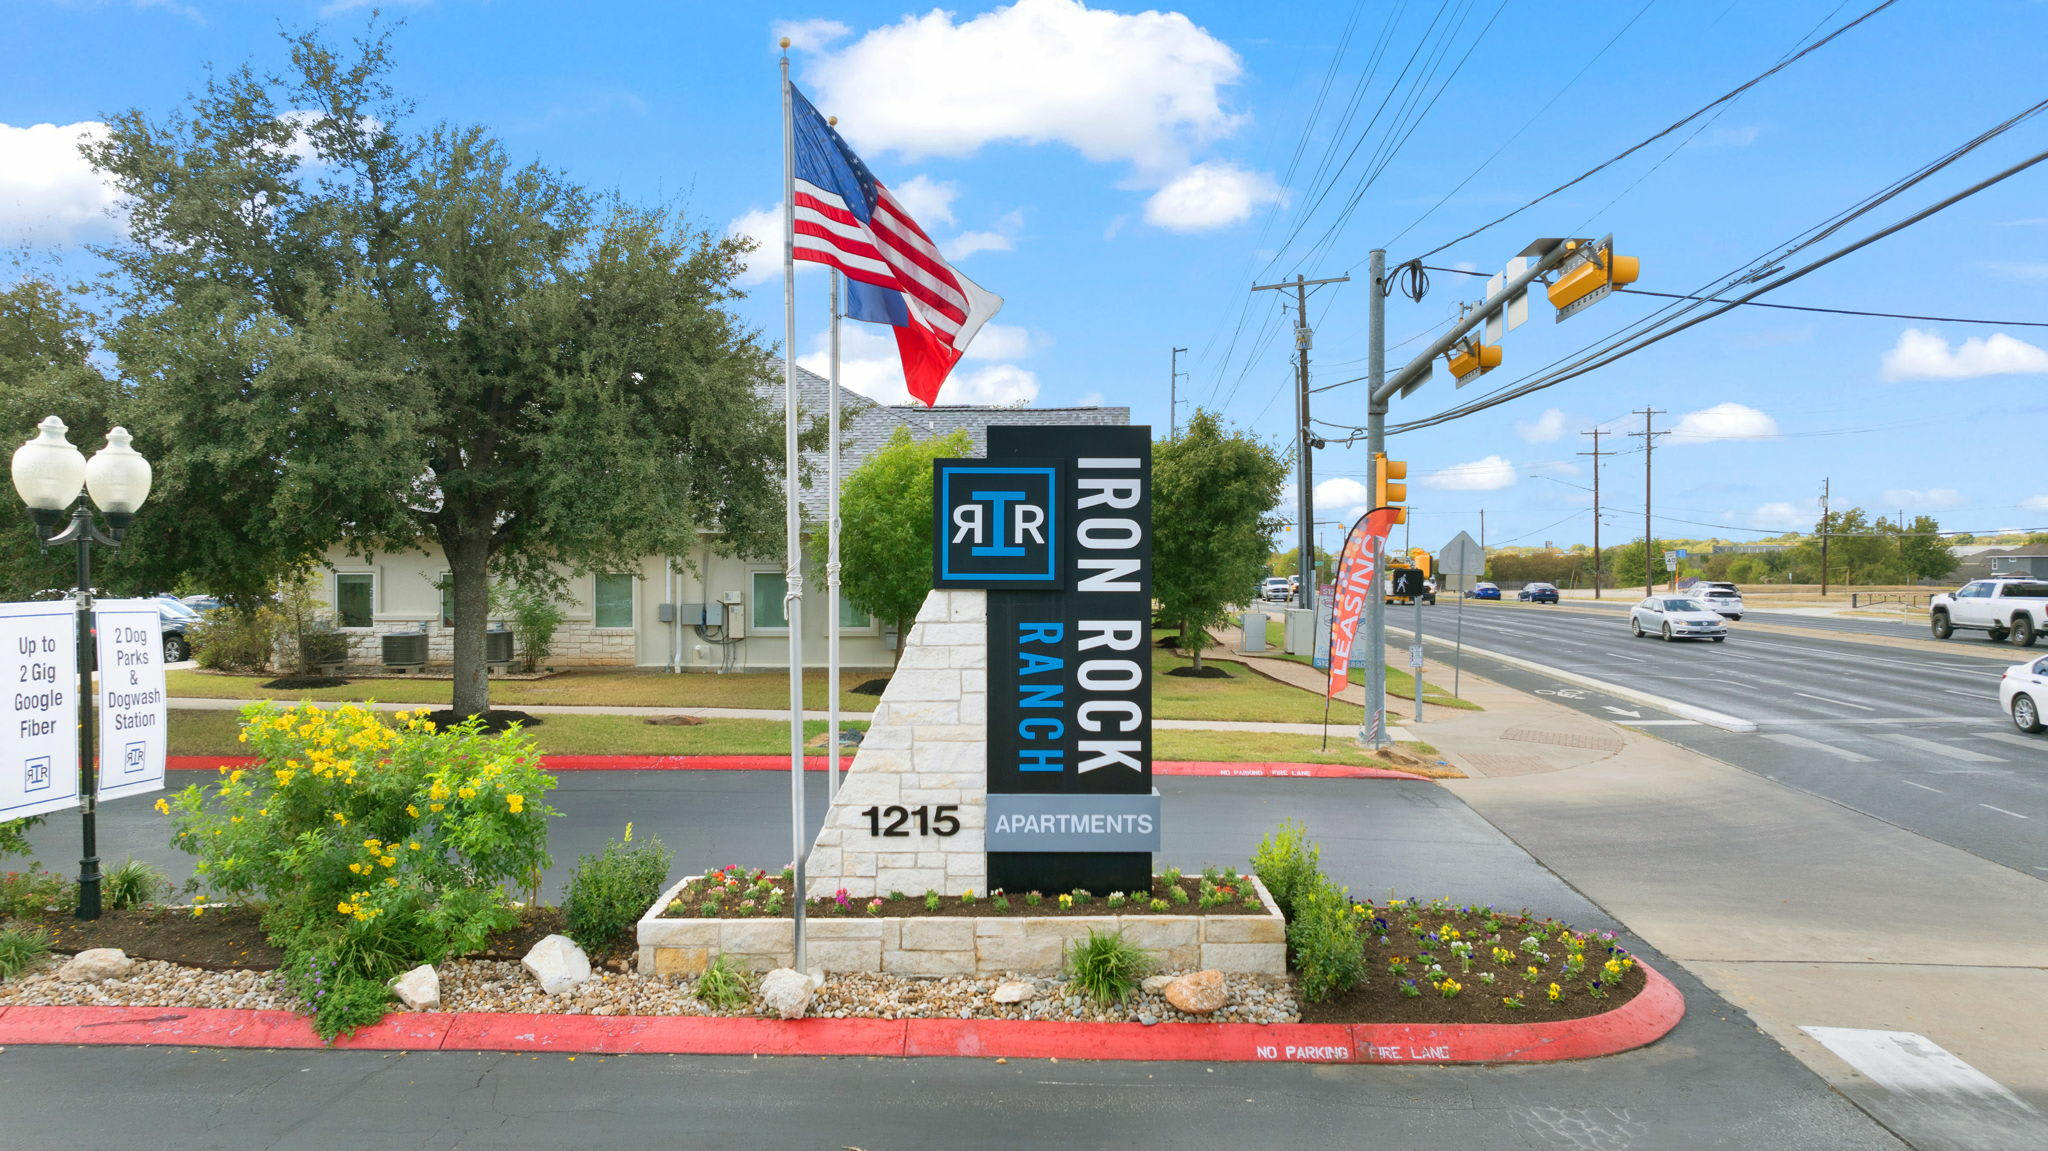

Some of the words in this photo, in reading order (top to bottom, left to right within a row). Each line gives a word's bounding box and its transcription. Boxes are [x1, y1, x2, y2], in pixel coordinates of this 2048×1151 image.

[1077, 457, 1142, 592] IRON
[1333, 534, 1387, 676] LEASING
[19, 637, 35, 657] Up
[42, 635, 56, 653] to
[114, 628, 122, 644] 2
[125, 627, 147, 646] Dog
[117, 650, 149, 666] Parks
[20, 665, 28, 683] 2
[31, 663, 56, 684] Gig
[129, 669, 138, 685] &
[14, 689, 63, 712] Google
[108, 687, 161, 711] Dogwash
[1018, 622, 1064, 772] RANCH
[1077, 620, 1142, 774] ROCK
[20, 719, 57, 739] Fiber
[115, 713, 156, 731] Station
[861, 805, 961, 838] 1215
[994, 813, 1153, 835] APARTMENTS
[1257, 1046, 1278, 1060] NO
[1286, 1046, 1349, 1060] PARKING
[1369, 1046, 1402, 1060] FIRE
[1411, 1046, 1449, 1060] LANE
